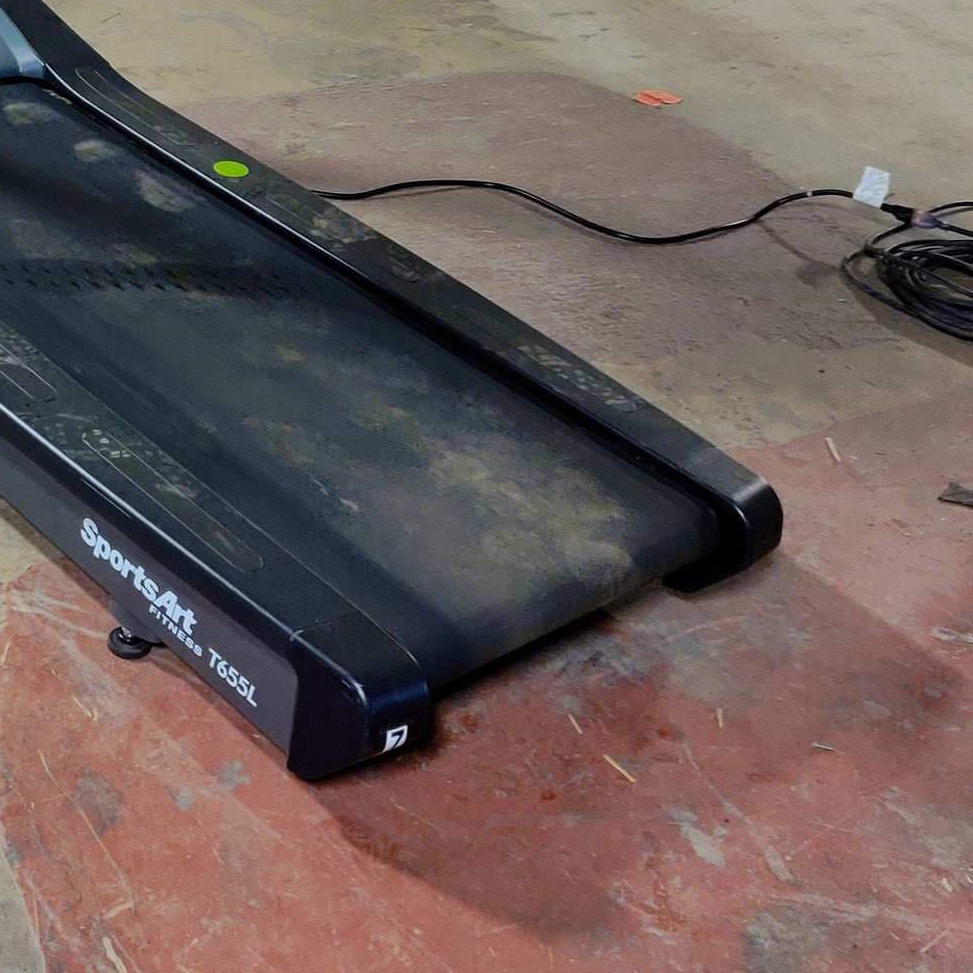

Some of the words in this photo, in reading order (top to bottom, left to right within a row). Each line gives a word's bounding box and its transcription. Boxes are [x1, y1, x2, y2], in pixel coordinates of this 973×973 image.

[80, 517, 198, 635] SportsArt
[148, 604, 204, 657] FITNESS
[208, 647, 258, 708] T655L
